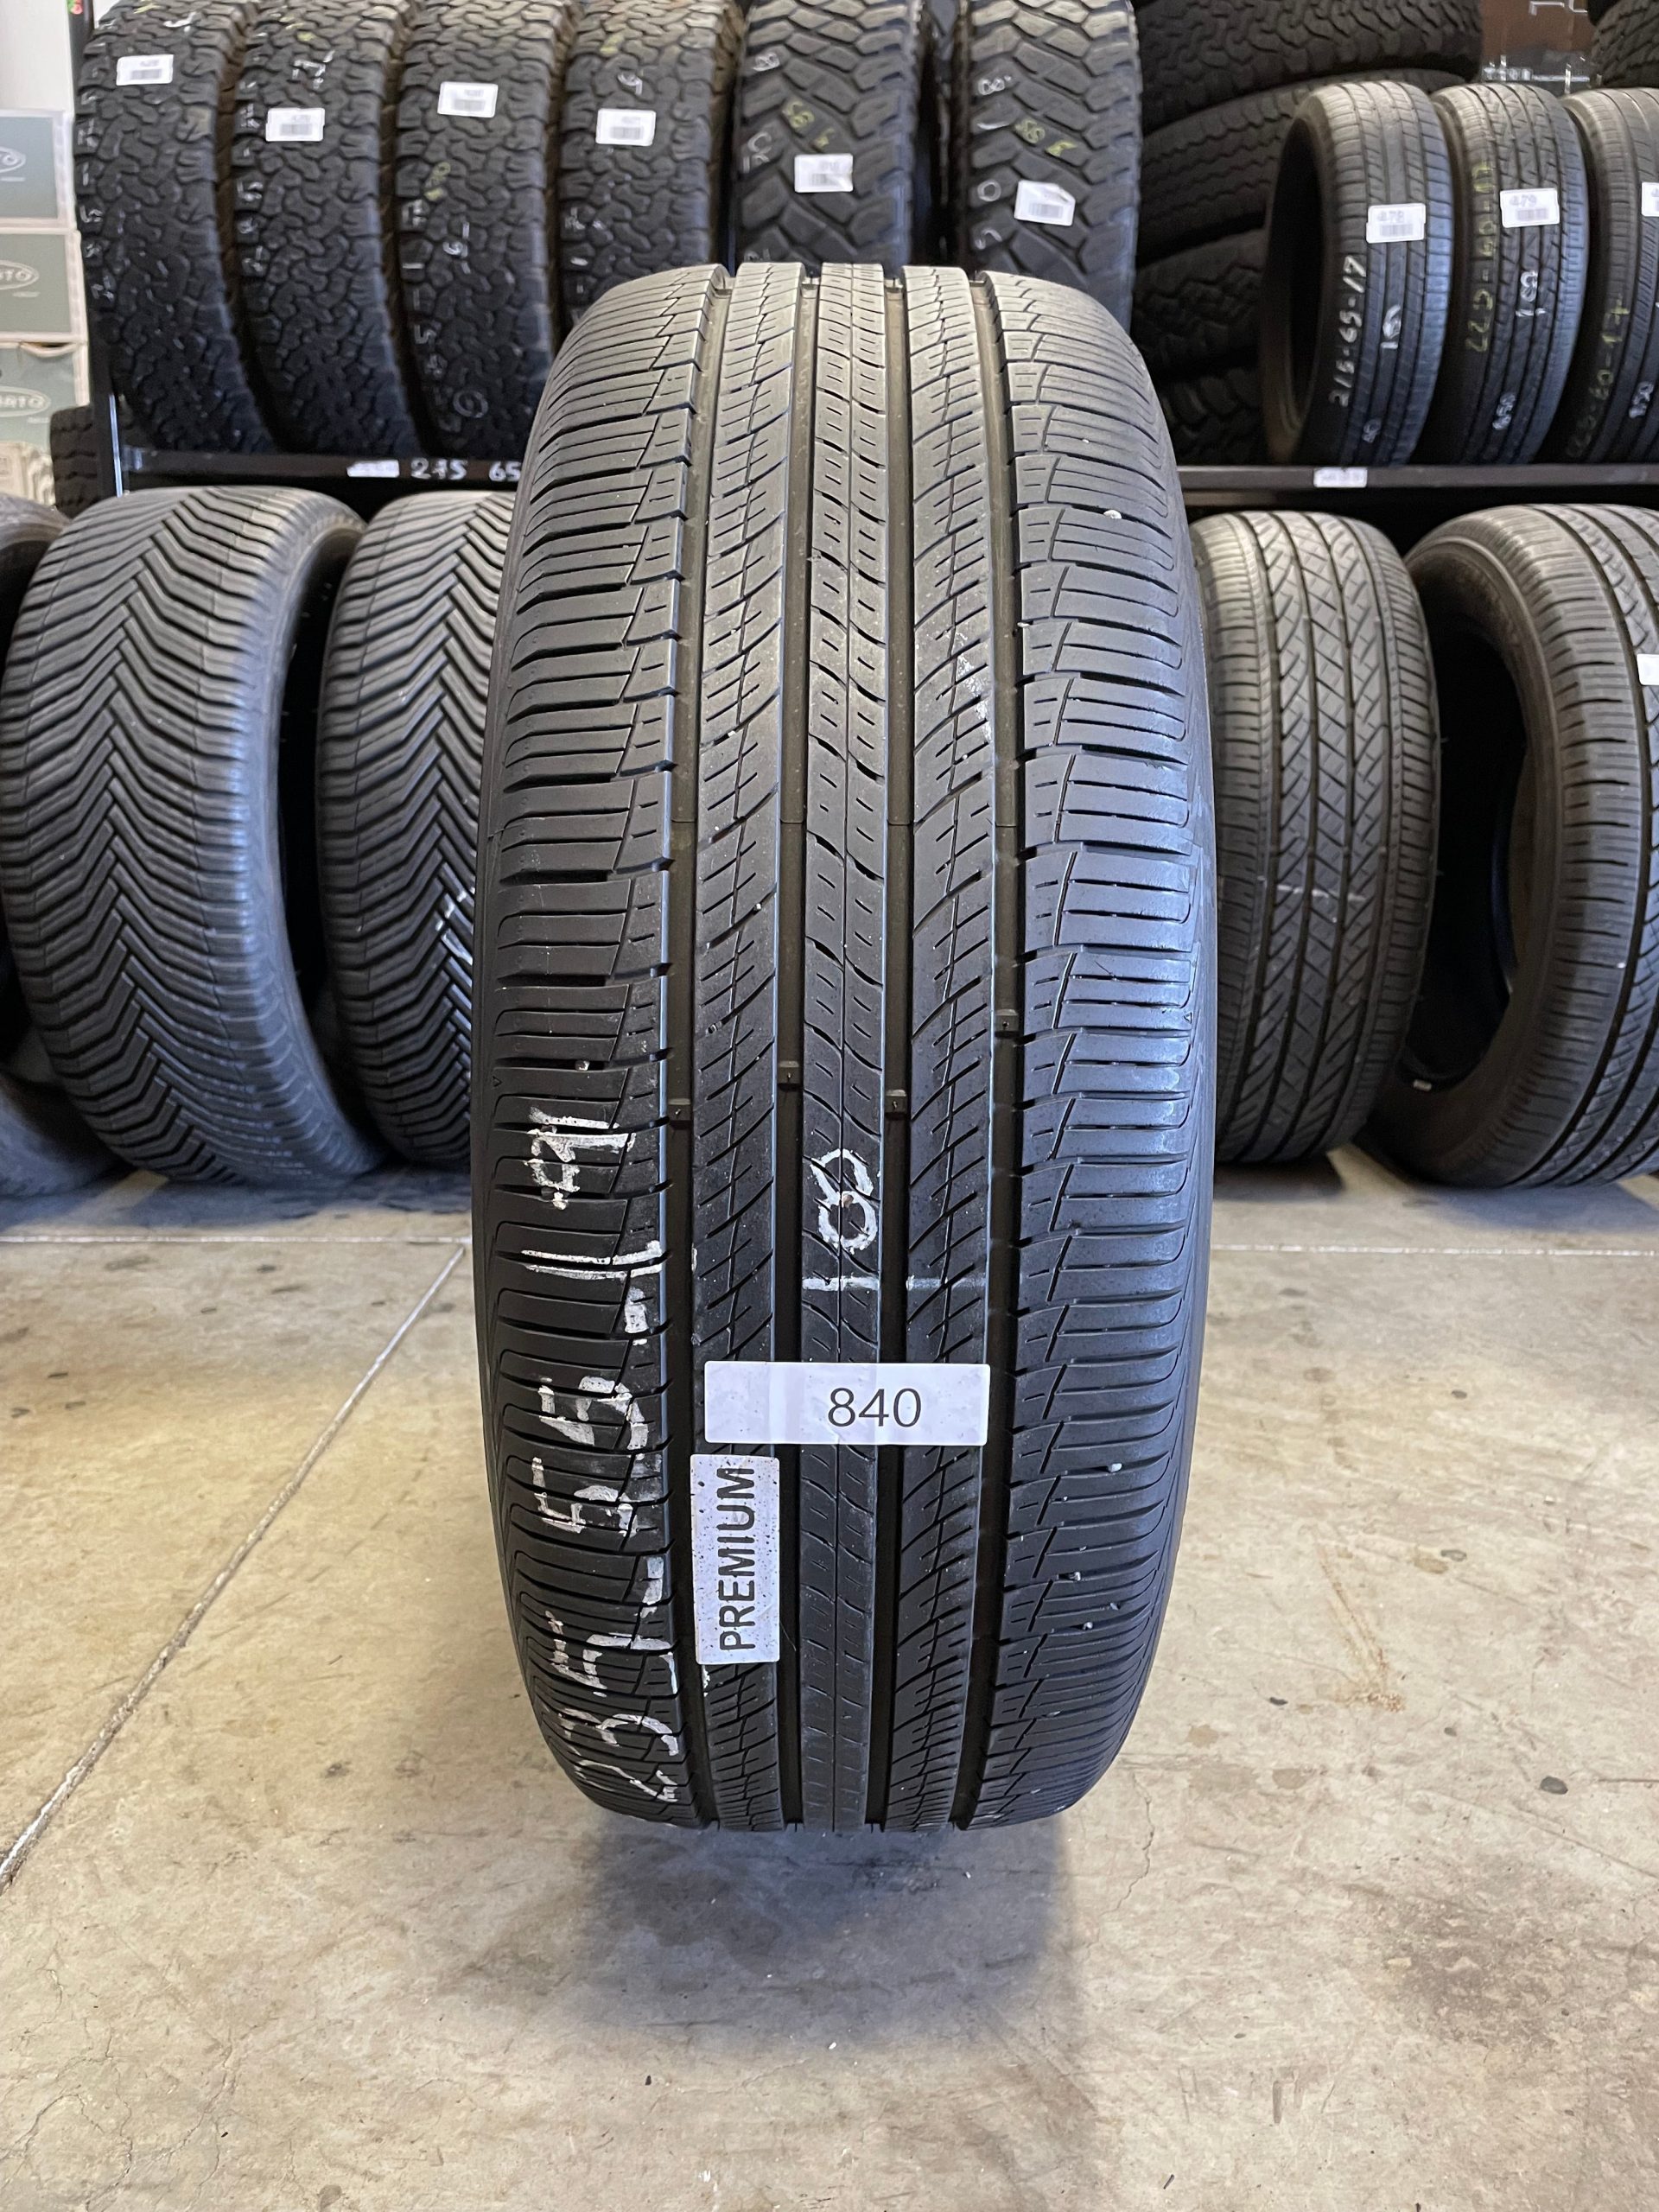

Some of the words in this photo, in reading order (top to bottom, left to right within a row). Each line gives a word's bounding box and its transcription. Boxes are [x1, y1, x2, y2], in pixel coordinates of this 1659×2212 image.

[1328, 256, 1367, 408] 215-65-17
[827, 1387, 923, 1428] 840
[716, 1467, 756, 1651] PREMIUM
